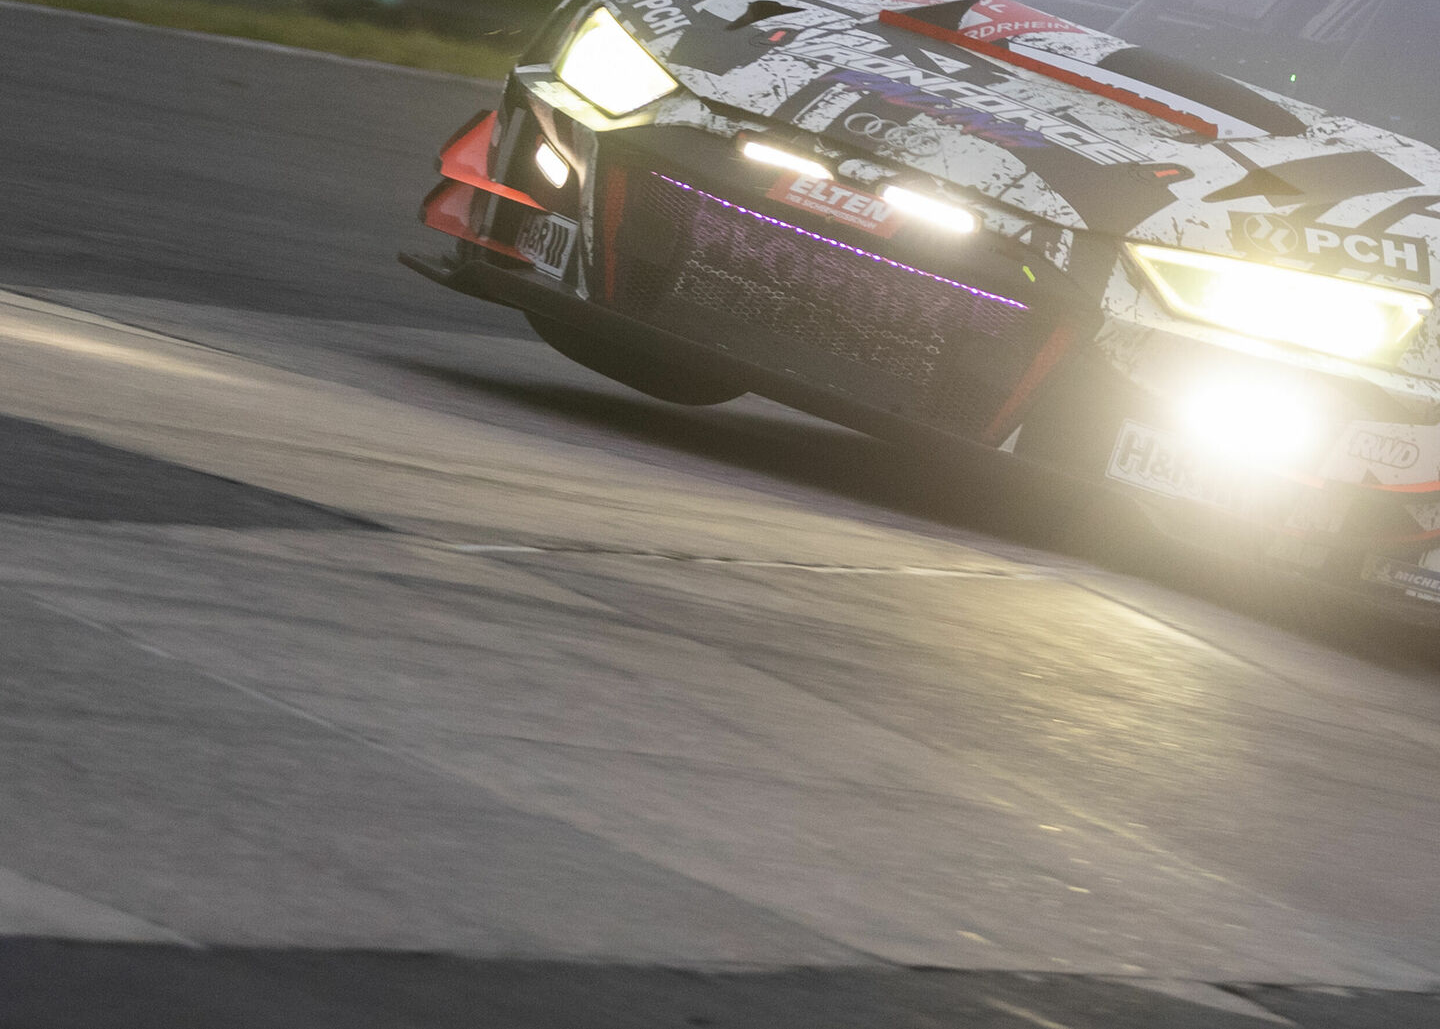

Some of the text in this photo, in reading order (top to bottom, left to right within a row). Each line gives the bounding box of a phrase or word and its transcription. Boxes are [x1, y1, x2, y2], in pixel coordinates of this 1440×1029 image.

[962, 20, 1073, 42] RDRHEIN
[789, 174, 895, 222] ELTEN
[1304, 227, 1419, 273] PCH
